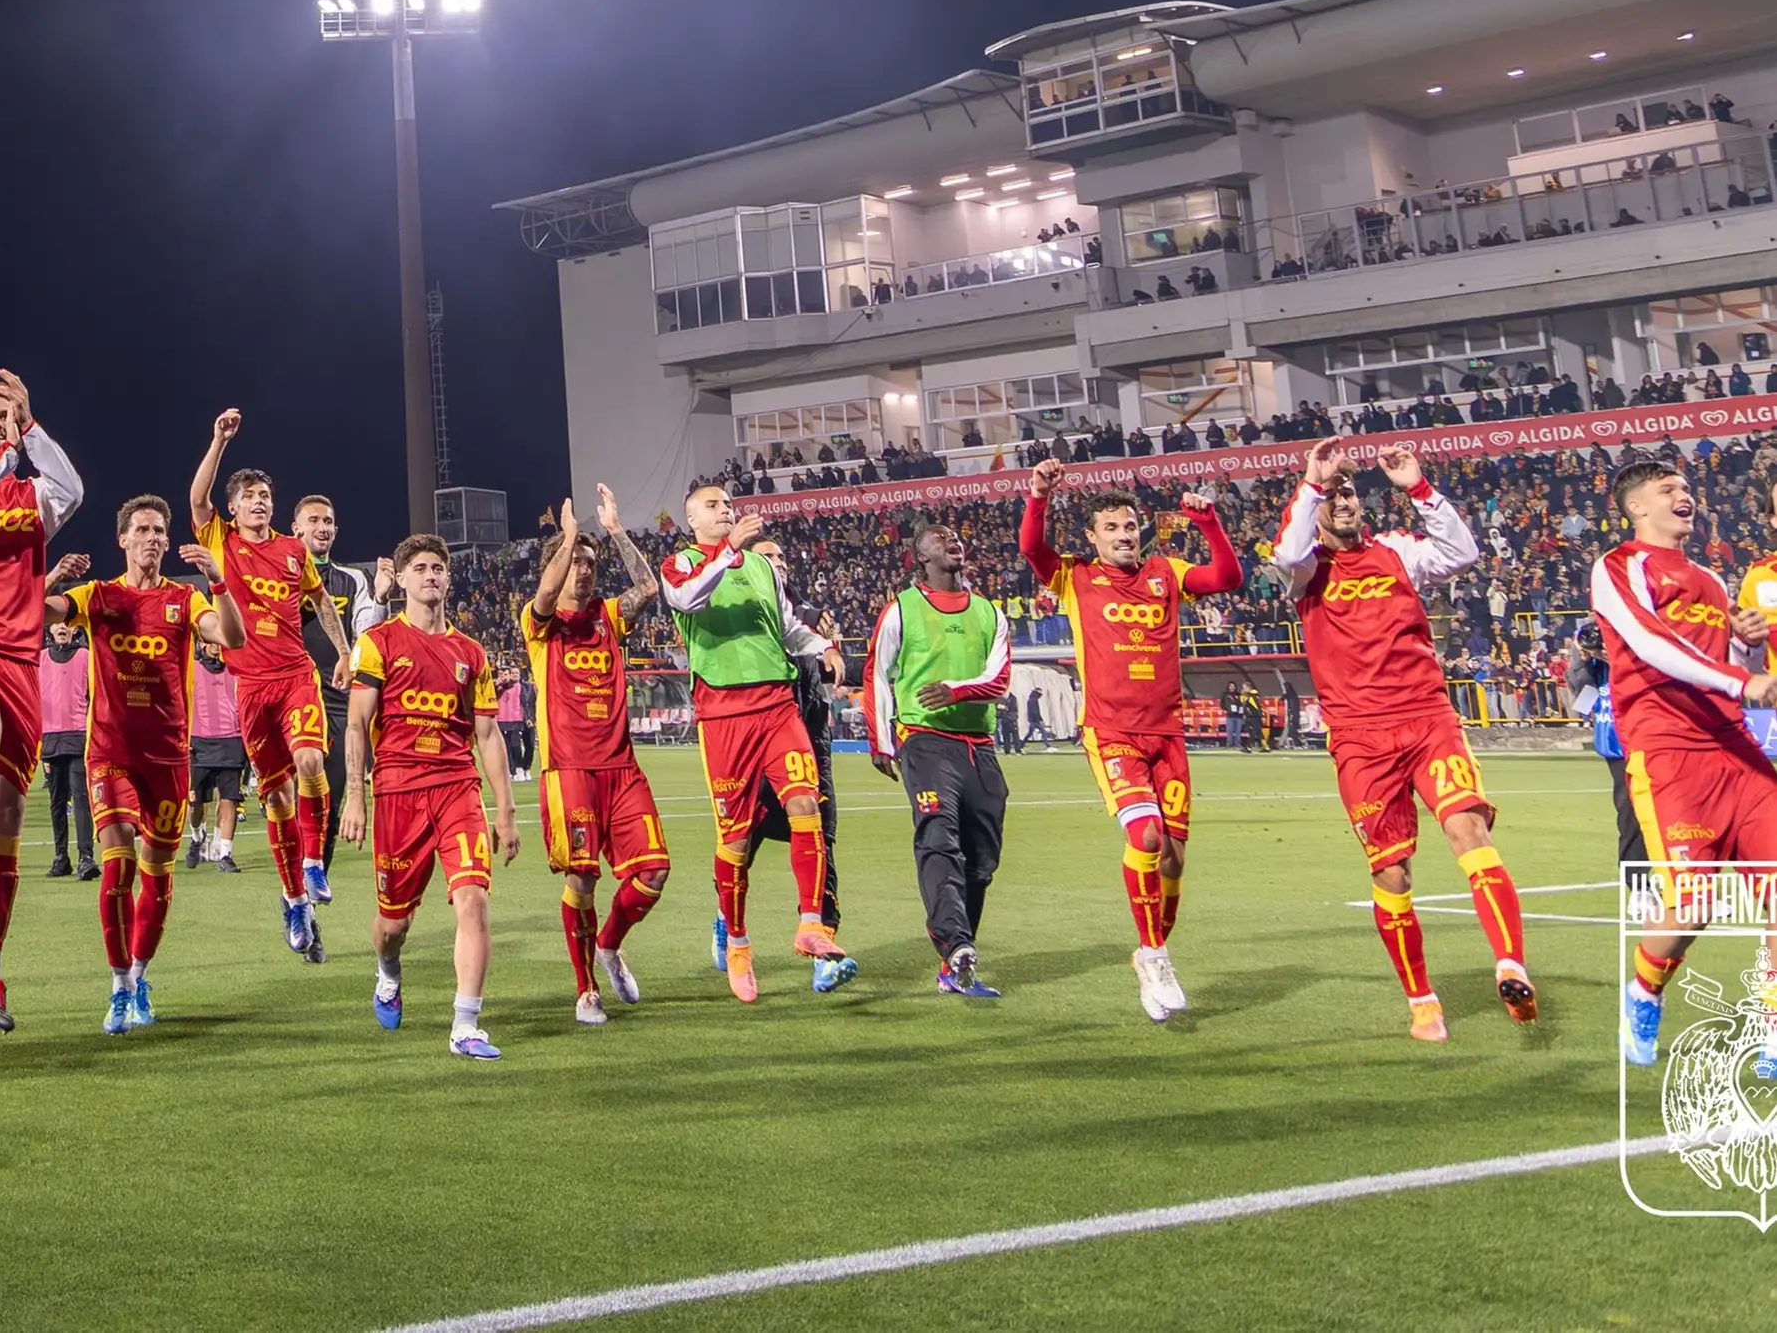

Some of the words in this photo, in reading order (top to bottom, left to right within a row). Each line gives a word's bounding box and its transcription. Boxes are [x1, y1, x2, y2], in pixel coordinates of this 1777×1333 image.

[760, 501, 799, 514] ALGIDA
[818, 496, 859, 509] ALGIDA
[880, 490, 922, 504] ALGIDA
[945, 483, 990, 497] ALGIDA
[1085, 470, 1134, 484] ALGIDA
[1161, 461, 1214, 476] ALGIDA
[1243, 453, 1299, 469] ALGIDA
[1420, 436, 1484, 453] ALGIDA
[1517, 424, 1585, 444] ALGIDA
[1621, 415, 1694, 435] ALGIDA
[1323, 575, 1397, 602] USCZ
[1103, 602, 1165, 629] coop
[1667, 599, 1726, 629] USCZ
[109, 633, 168, 660] coop
[564, 650, 611, 674] coop
[401, 688, 458, 719] coop
[289, 704, 321, 736] 32
[785, 751, 819, 786] 98
[1429, 754, 1474, 798] 28
[916, 791, 939, 804] US
[1161, 779, 1189, 817] 9
[155, 799, 187, 834] 84
[456, 831, 490, 869] 14
